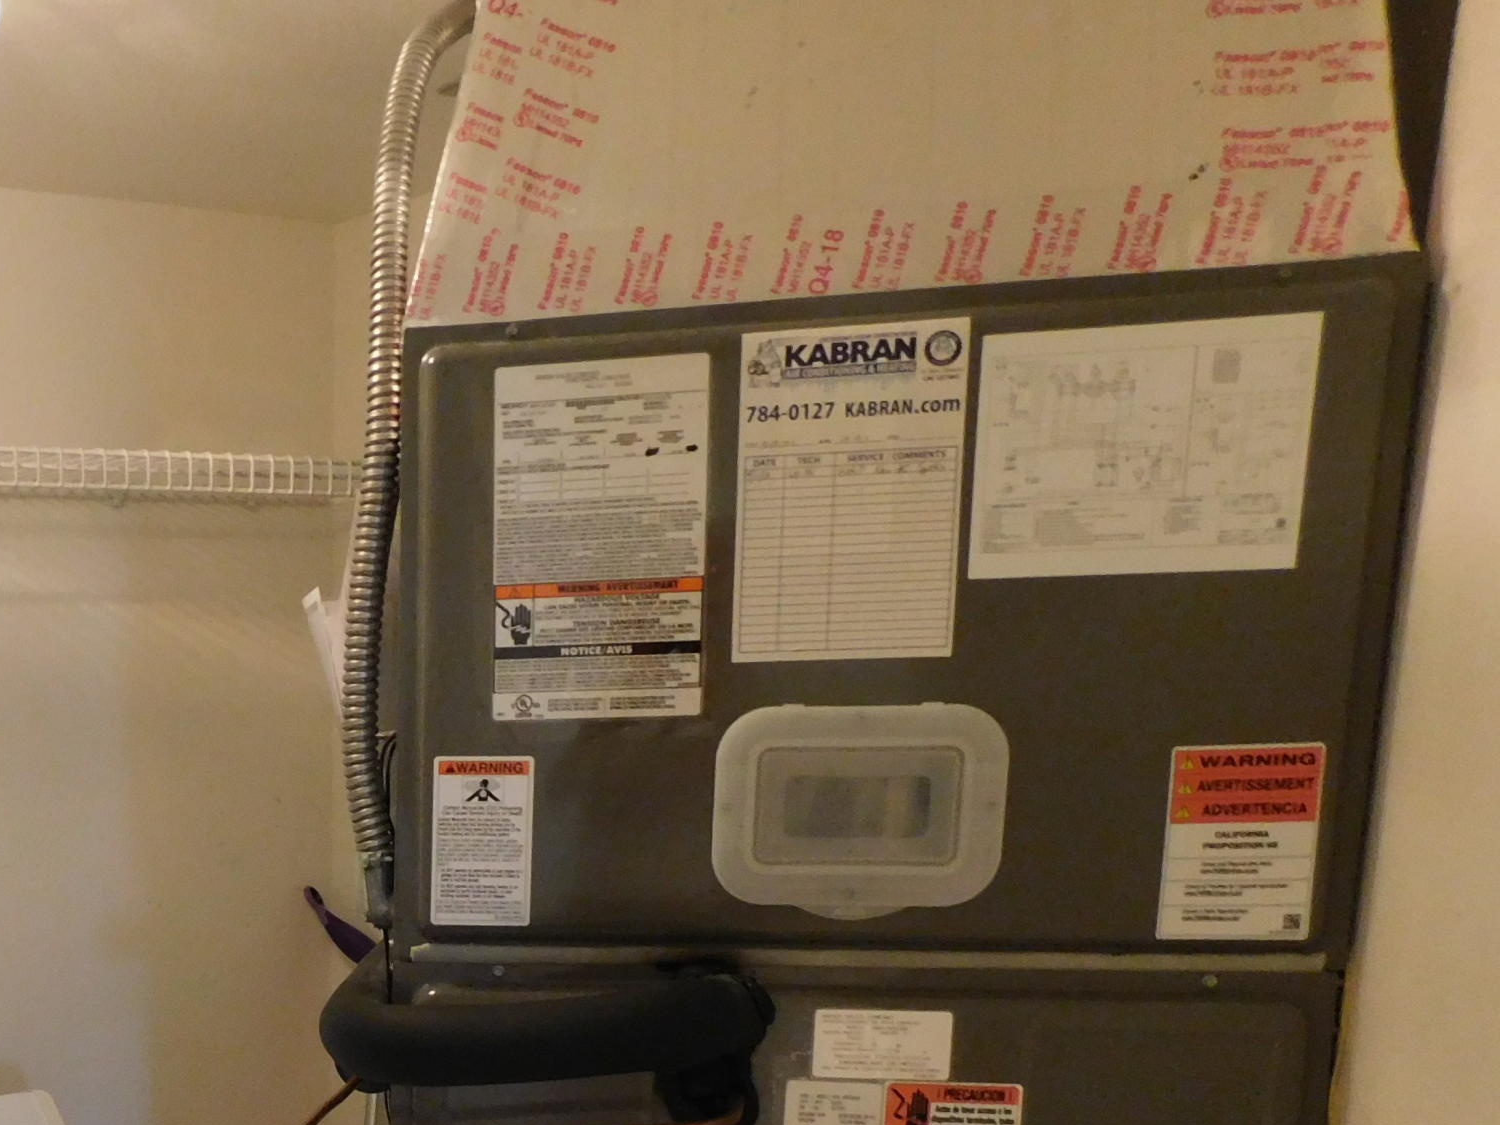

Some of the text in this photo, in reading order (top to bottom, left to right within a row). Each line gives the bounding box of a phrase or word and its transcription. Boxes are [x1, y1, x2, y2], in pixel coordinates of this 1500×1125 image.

[808, 229, 844, 295] Q4-18
[784, 336, 917, 368] KABRAN
[745, 402, 835, 423] 784-0127
[845, 398, 961, 418] KABRAN.com
[456, 762, 525, 774] WARNING
[1200, 752, 1316, 768] WARNING
[1197, 777, 1315, 792] AVERTISSEMENT
[1202, 802, 1308, 816] ADVERTENCIA
